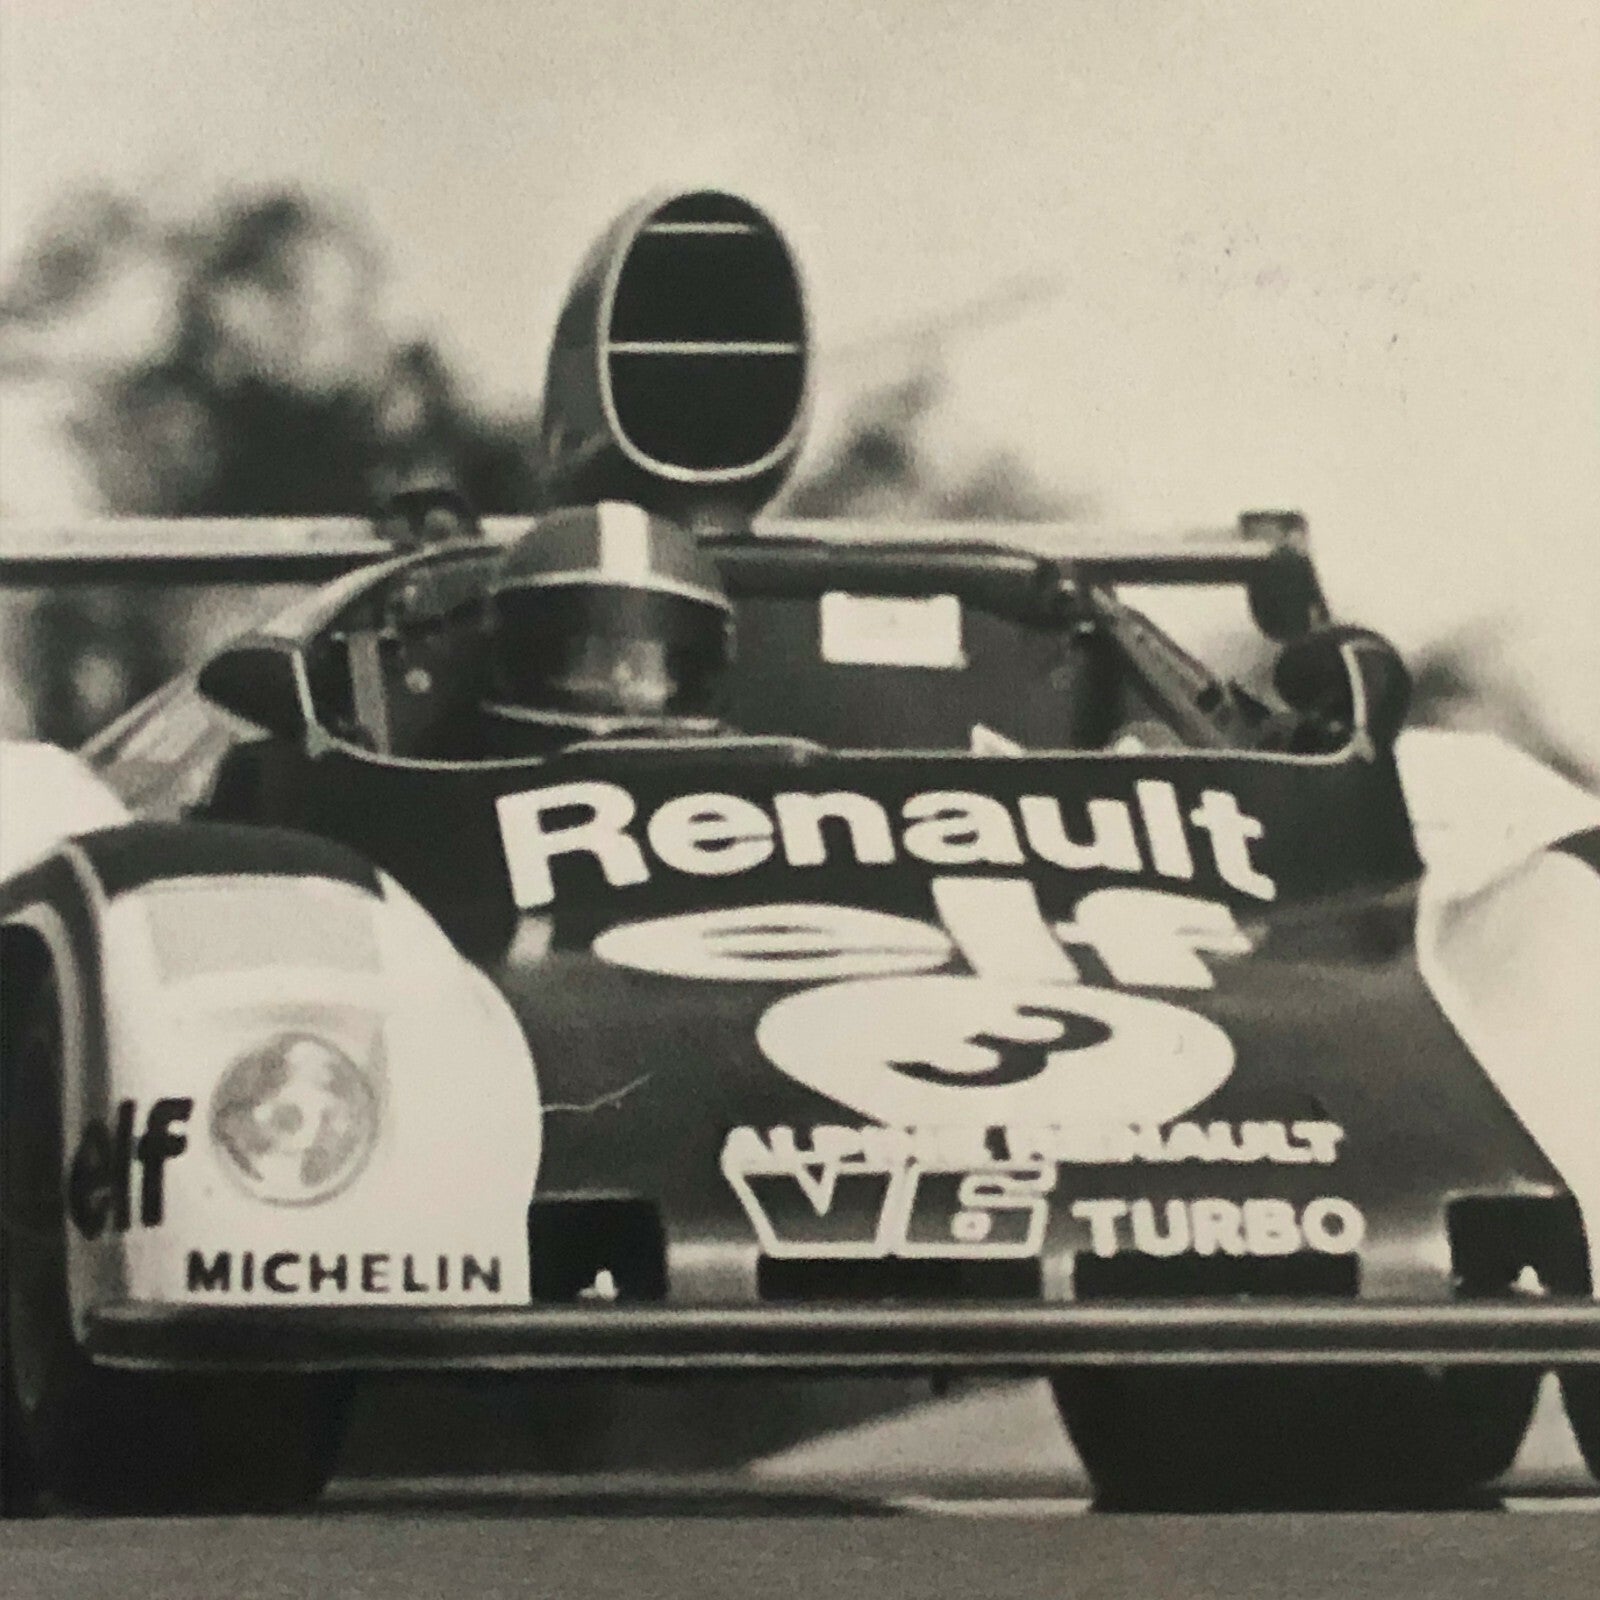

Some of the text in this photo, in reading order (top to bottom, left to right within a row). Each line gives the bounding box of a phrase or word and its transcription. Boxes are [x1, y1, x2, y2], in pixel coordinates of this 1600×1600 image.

[495, 780, 1277, 909] Renault
[592, 876, 1258, 990] elf
[886, 1004, 1113, 1087] 3
[69, 1097, 194, 1241] elf
[1004, 1120, 1345, 1164] RNAULT
[1071, 1197, 1366, 1258] TURBO
[186, 1250, 502, 1294] MICHELIN
